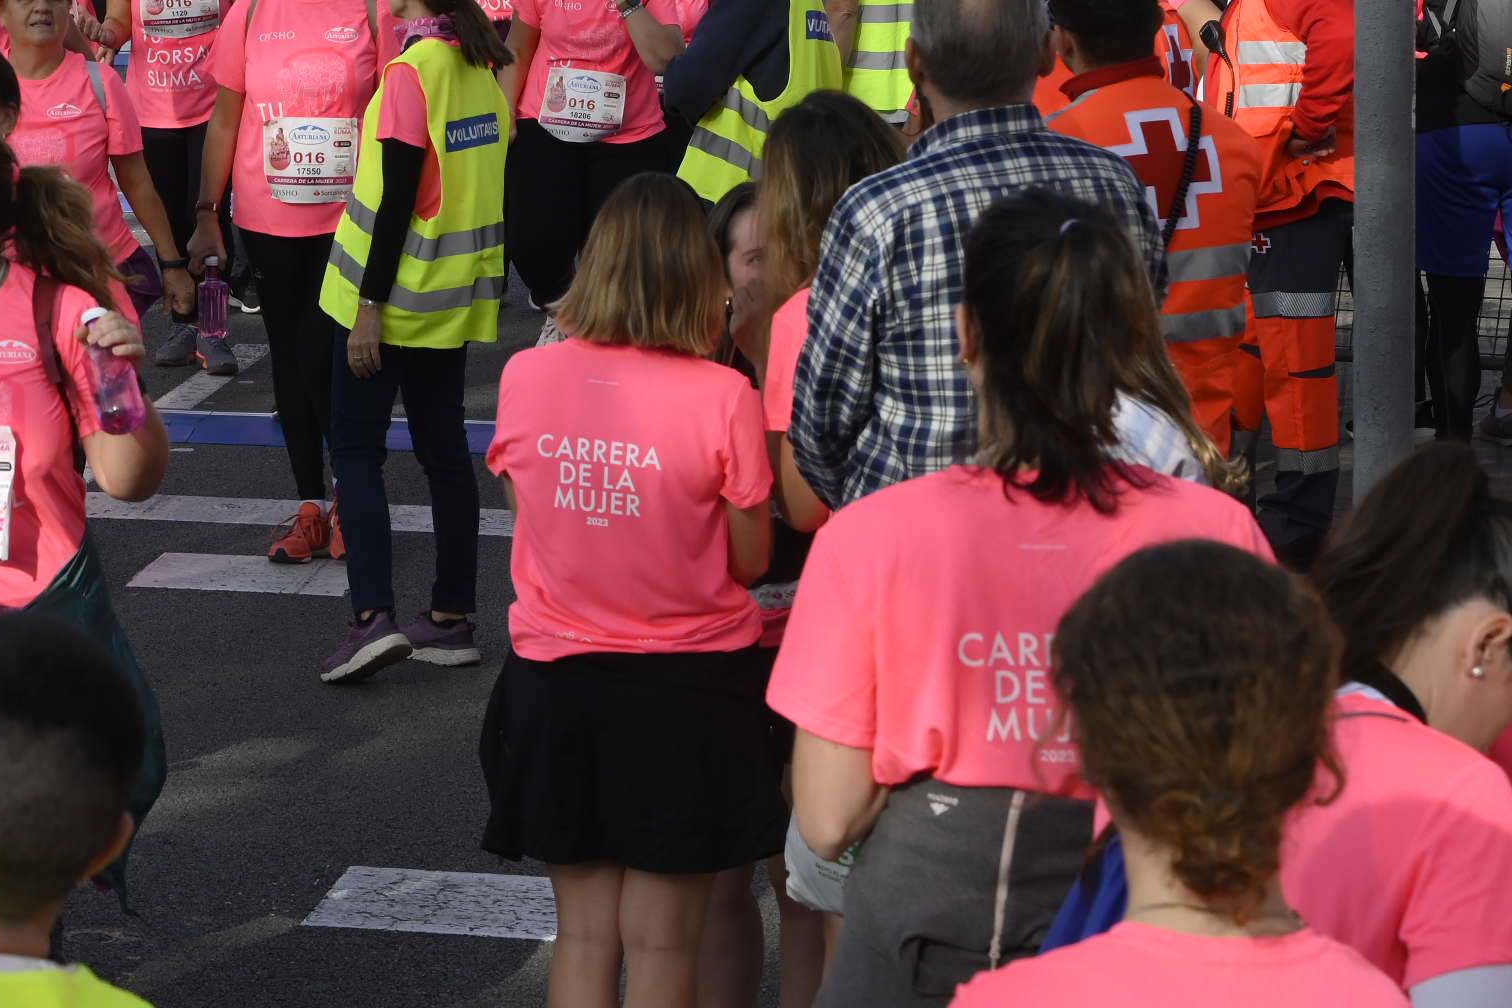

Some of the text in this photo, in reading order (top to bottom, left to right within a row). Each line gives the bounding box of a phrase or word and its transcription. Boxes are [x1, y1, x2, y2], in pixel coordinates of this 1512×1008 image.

[148, 69, 201, 87] SUMA
[568, 97, 596, 111] 016
[569, 111, 592, 120] 18206
[293, 152, 325, 164] 016
[296, 167, 322, 176] 17550
[537, 433, 662, 471] CARRERA
[559, 461, 636, 492] DE LA
[554, 486, 641, 518] MUJER
[586, 516, 609, 527] 2023
[995, 669, 1048, 705] DE
